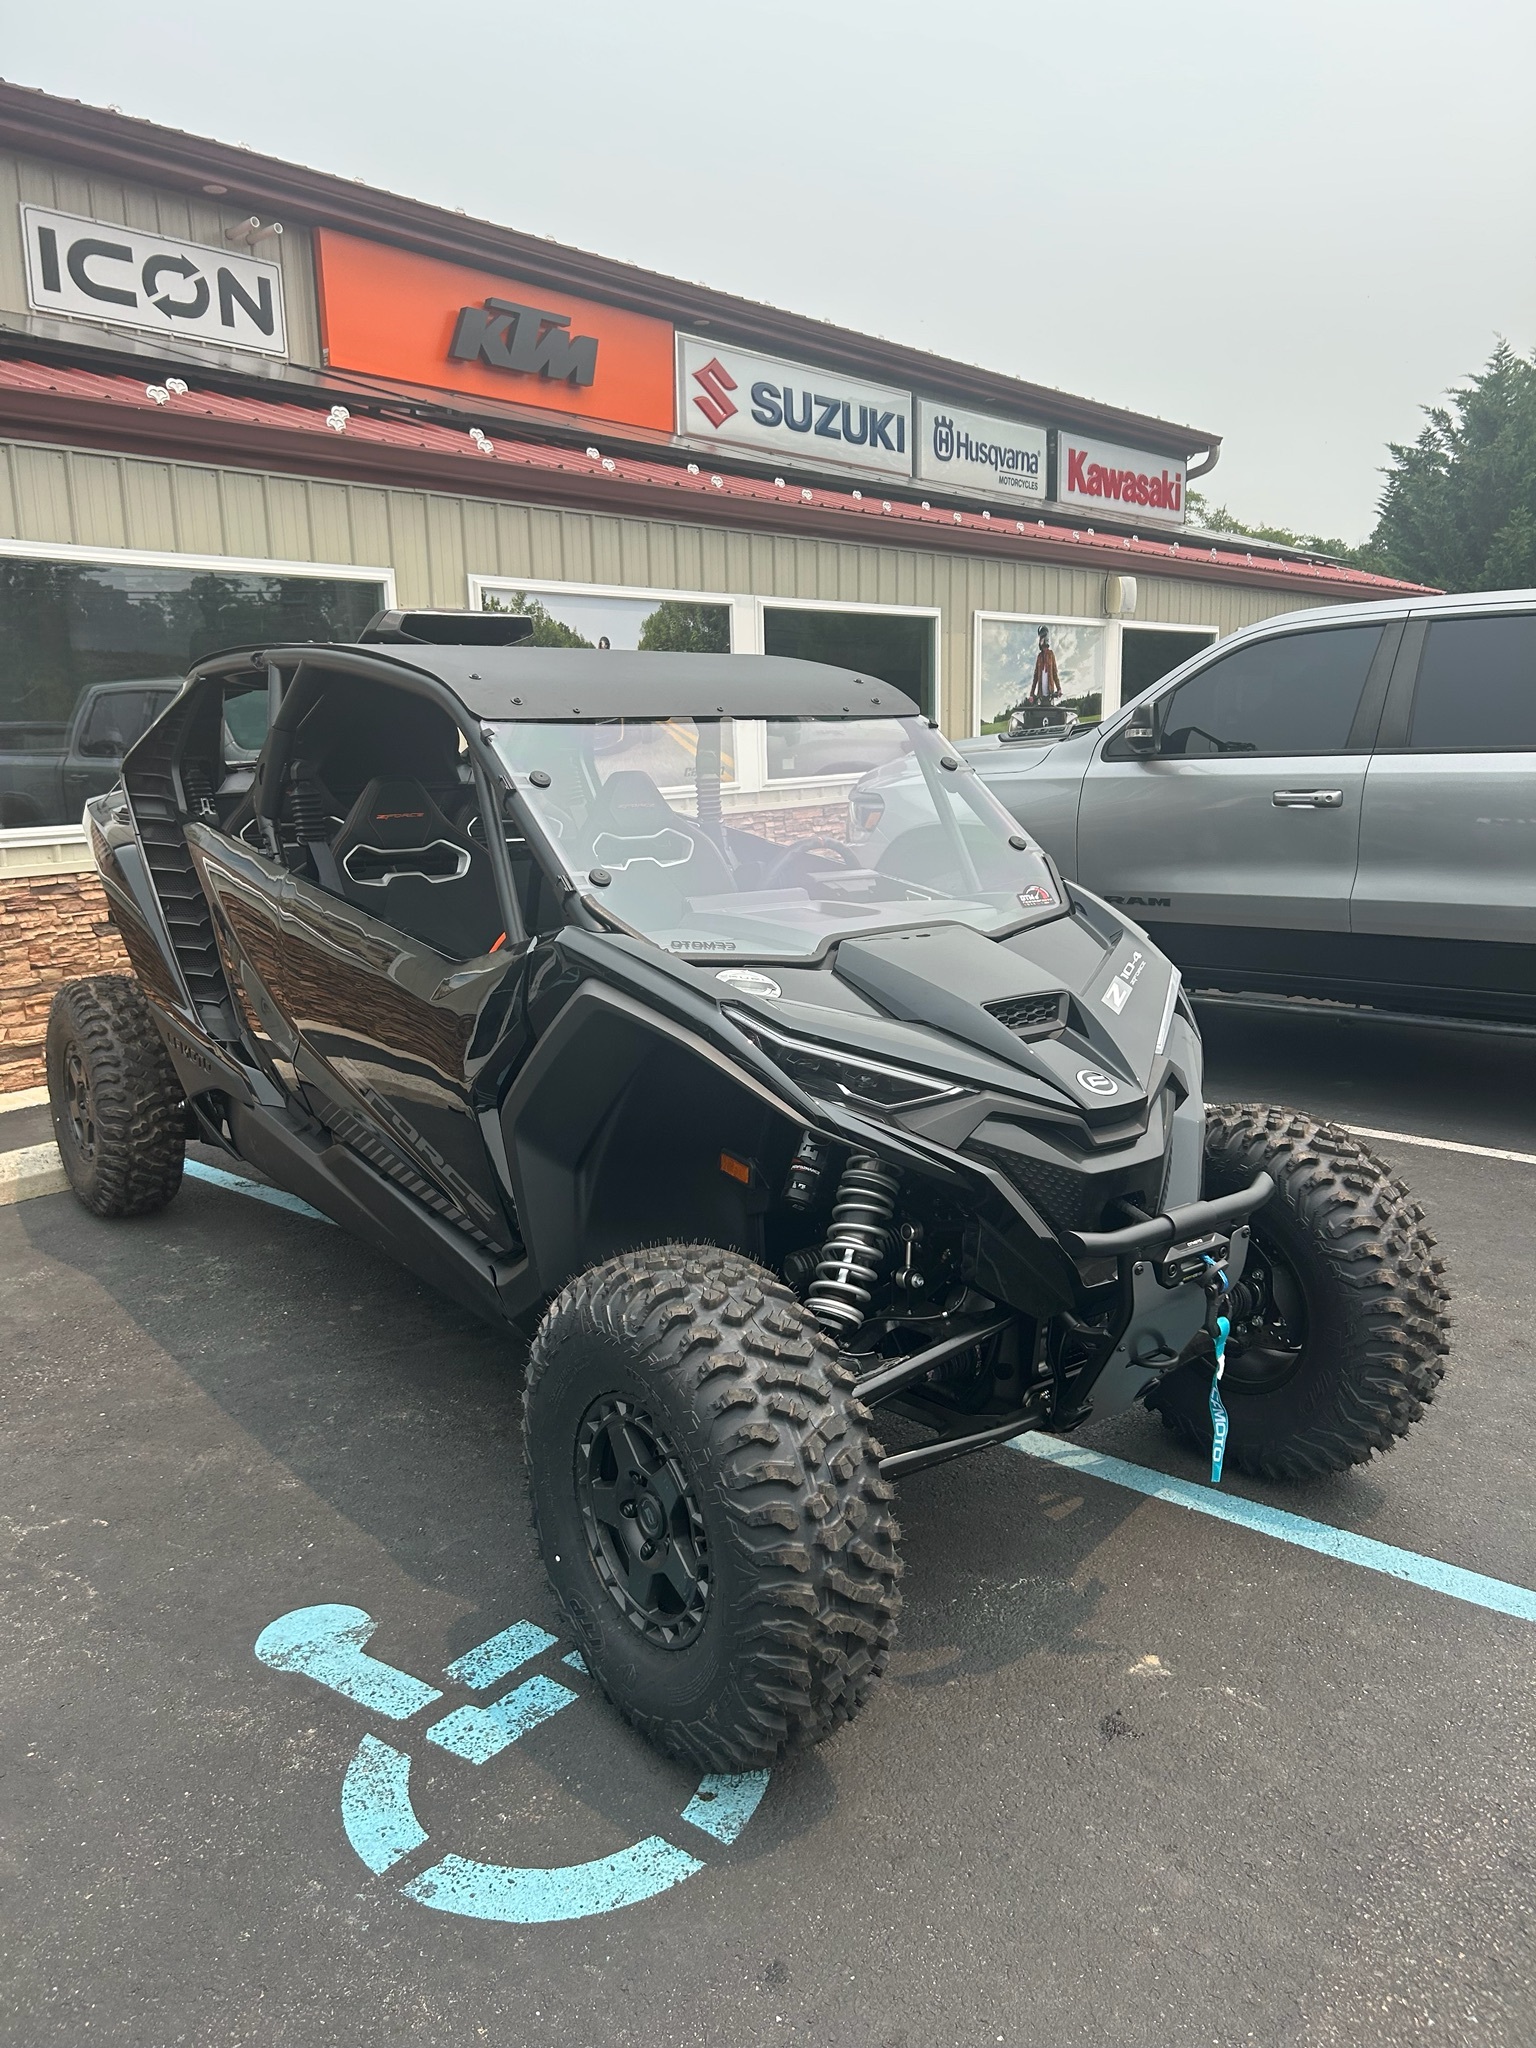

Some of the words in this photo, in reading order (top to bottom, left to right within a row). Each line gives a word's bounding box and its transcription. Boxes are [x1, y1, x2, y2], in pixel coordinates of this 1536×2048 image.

[38, 226, 274, 336] ICON
[448, 297, 598, 387] KTM
[751, 381, 905, 453] SUZUKI
[956, 430, 1039, 474] Husqvarna
[998, 475, 1039, 491] MOTORCYCLES
[1067, 448, 1182, 511] Kawasaki
[1103, 895, 1171, 907] RAM
[1119, 951, 1143, 980] 10-4
